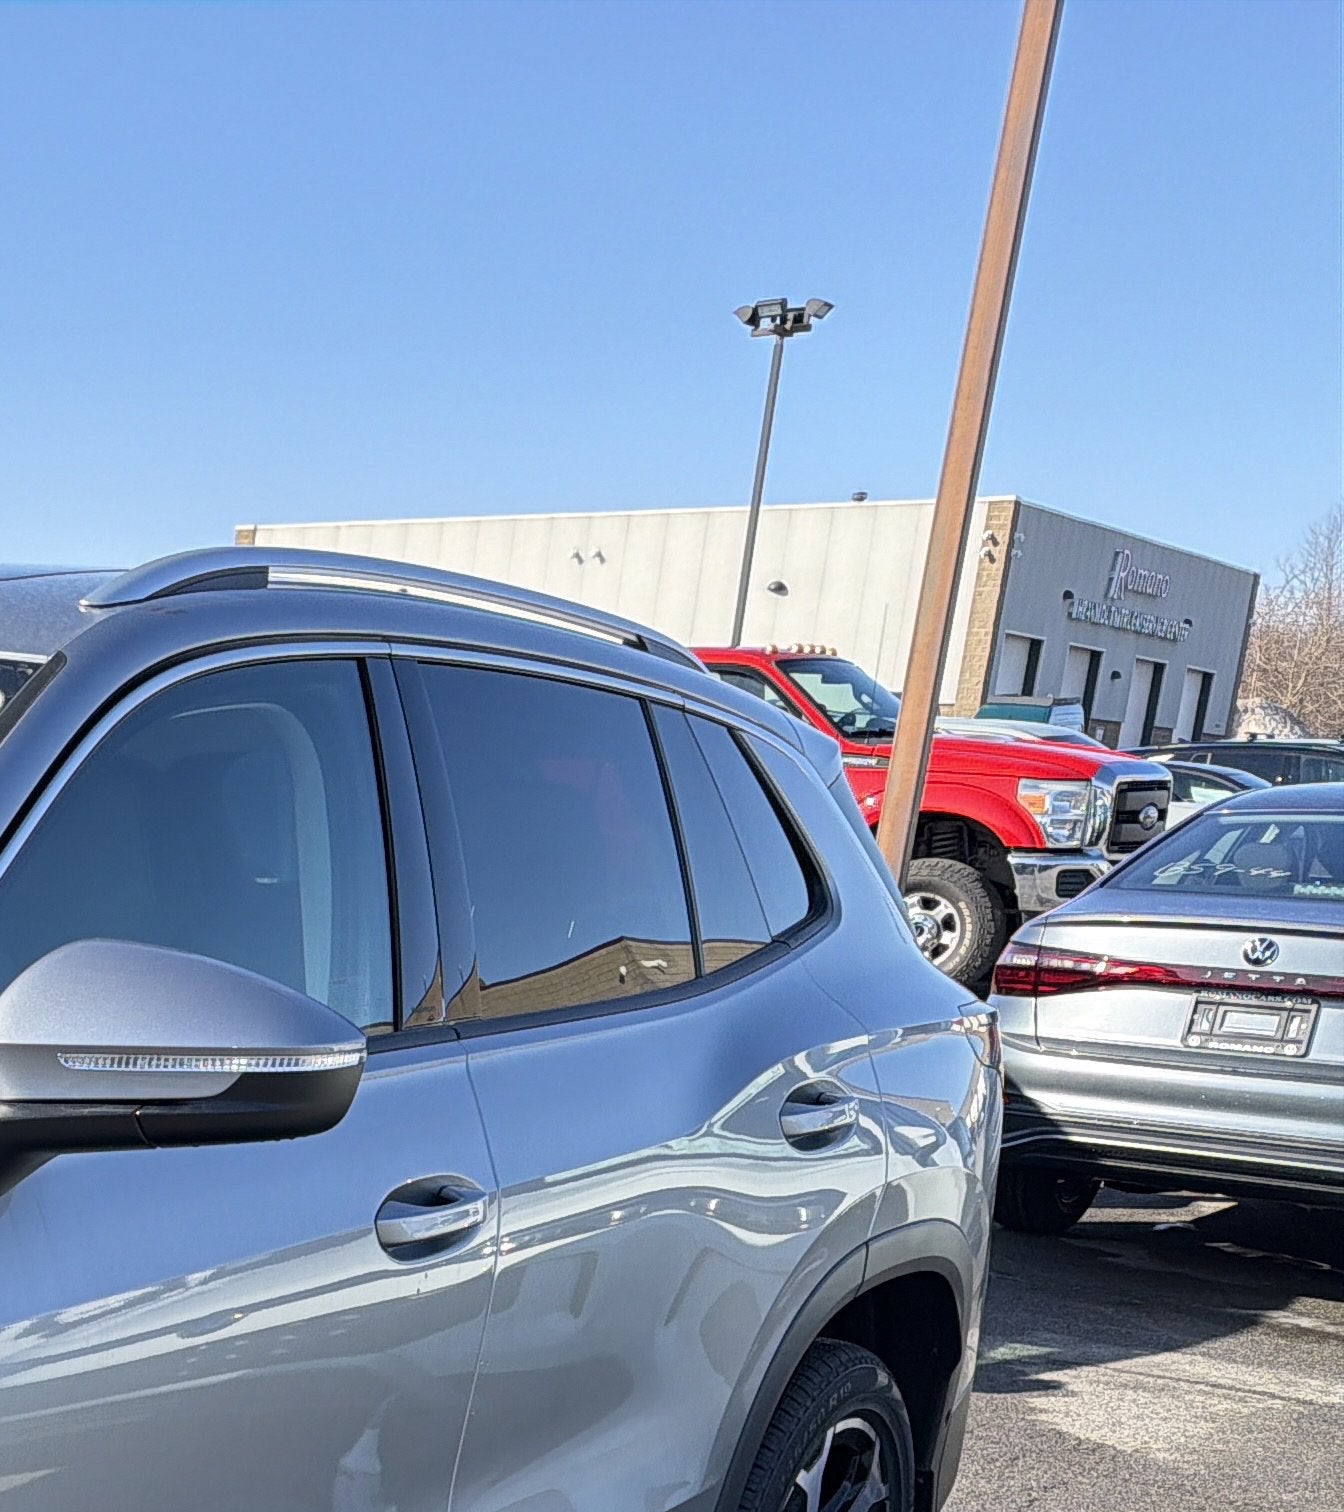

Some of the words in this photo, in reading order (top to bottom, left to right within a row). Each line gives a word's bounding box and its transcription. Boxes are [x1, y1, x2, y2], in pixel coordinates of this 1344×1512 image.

[1114, 549, 1170, 600] Romano
[1201, 970, 1307, 986] JETTA
[1208, 1040, 1275, 1054] ROMANO
